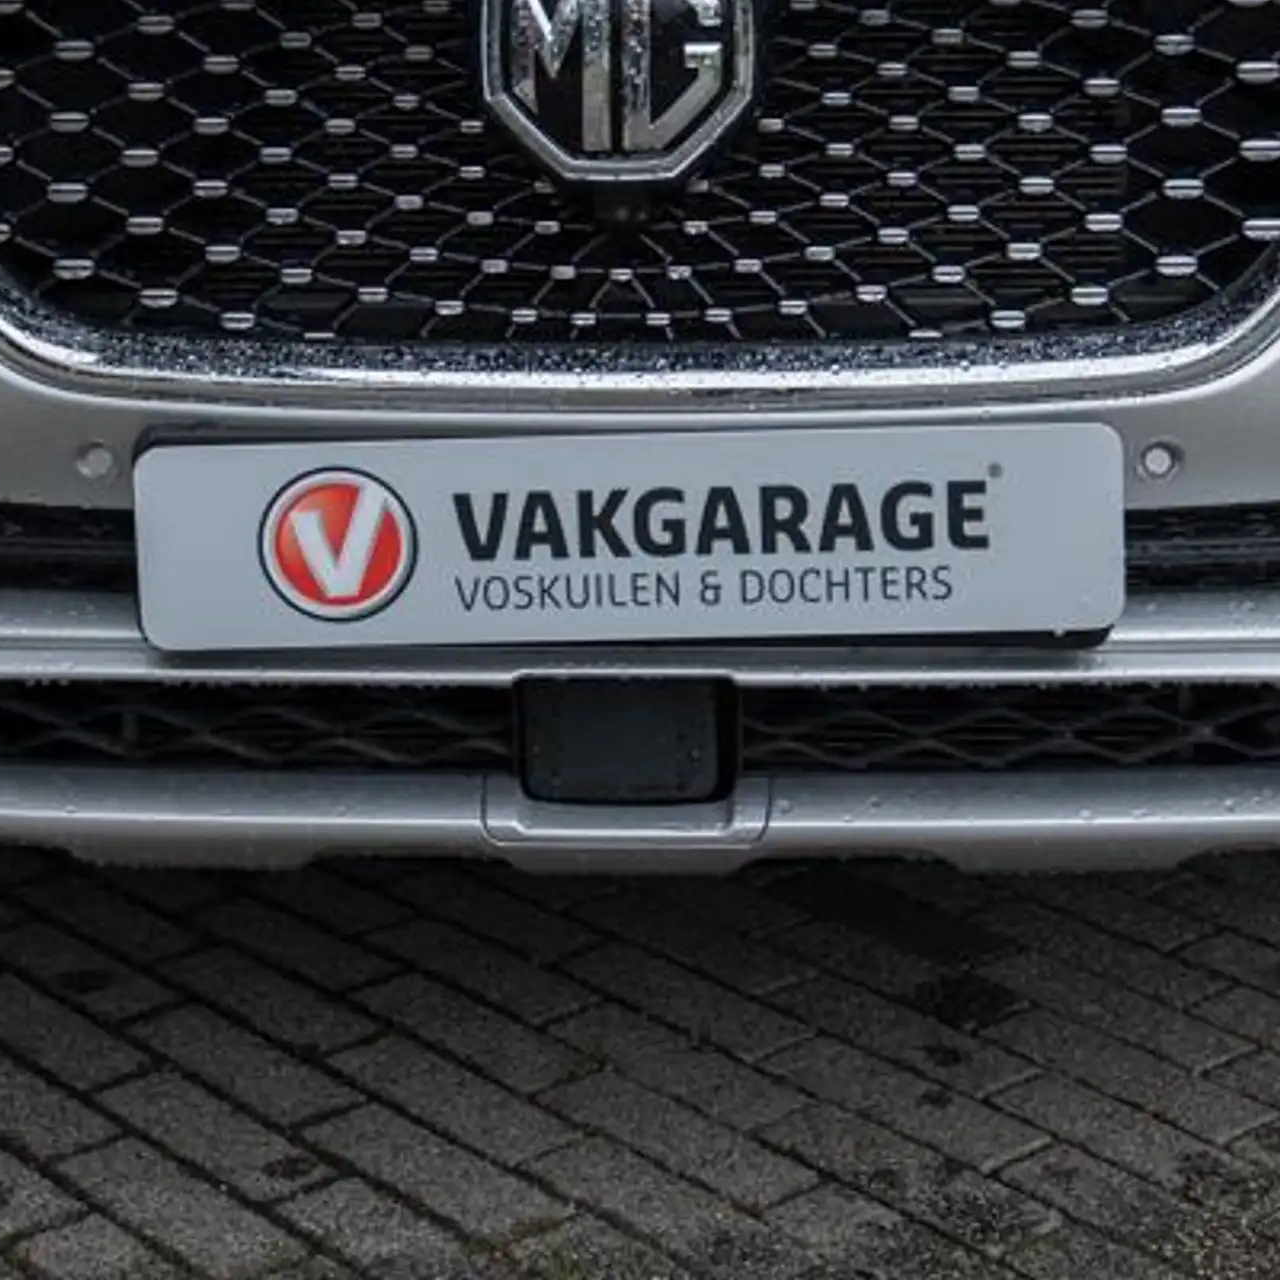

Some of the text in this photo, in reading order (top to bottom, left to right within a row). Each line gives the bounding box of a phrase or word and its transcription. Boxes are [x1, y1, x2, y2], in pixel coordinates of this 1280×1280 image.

[290, 483, 388, 597] V
[452, 480, 990, 562] VAKGARAGE
[455, 565, 954, 613] VOSKUILEN & DOCHTERS
